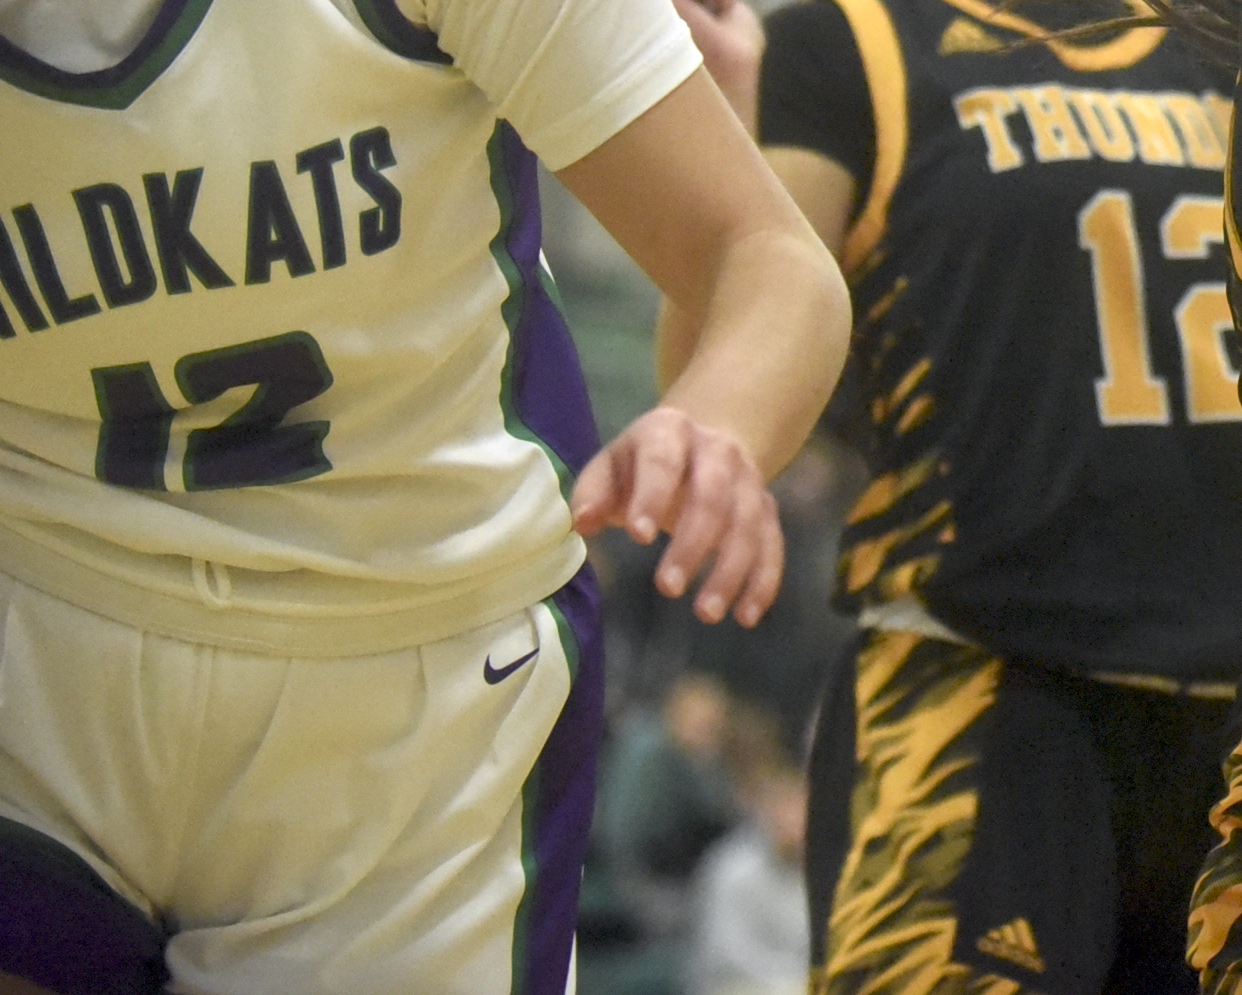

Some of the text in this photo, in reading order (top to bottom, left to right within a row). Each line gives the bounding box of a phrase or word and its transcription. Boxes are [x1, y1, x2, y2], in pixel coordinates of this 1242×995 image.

[953, 82, 1236, 173] THUND
[0, 126, 402, 340] ILDKATS
[90, 330, 334, 493] 12
